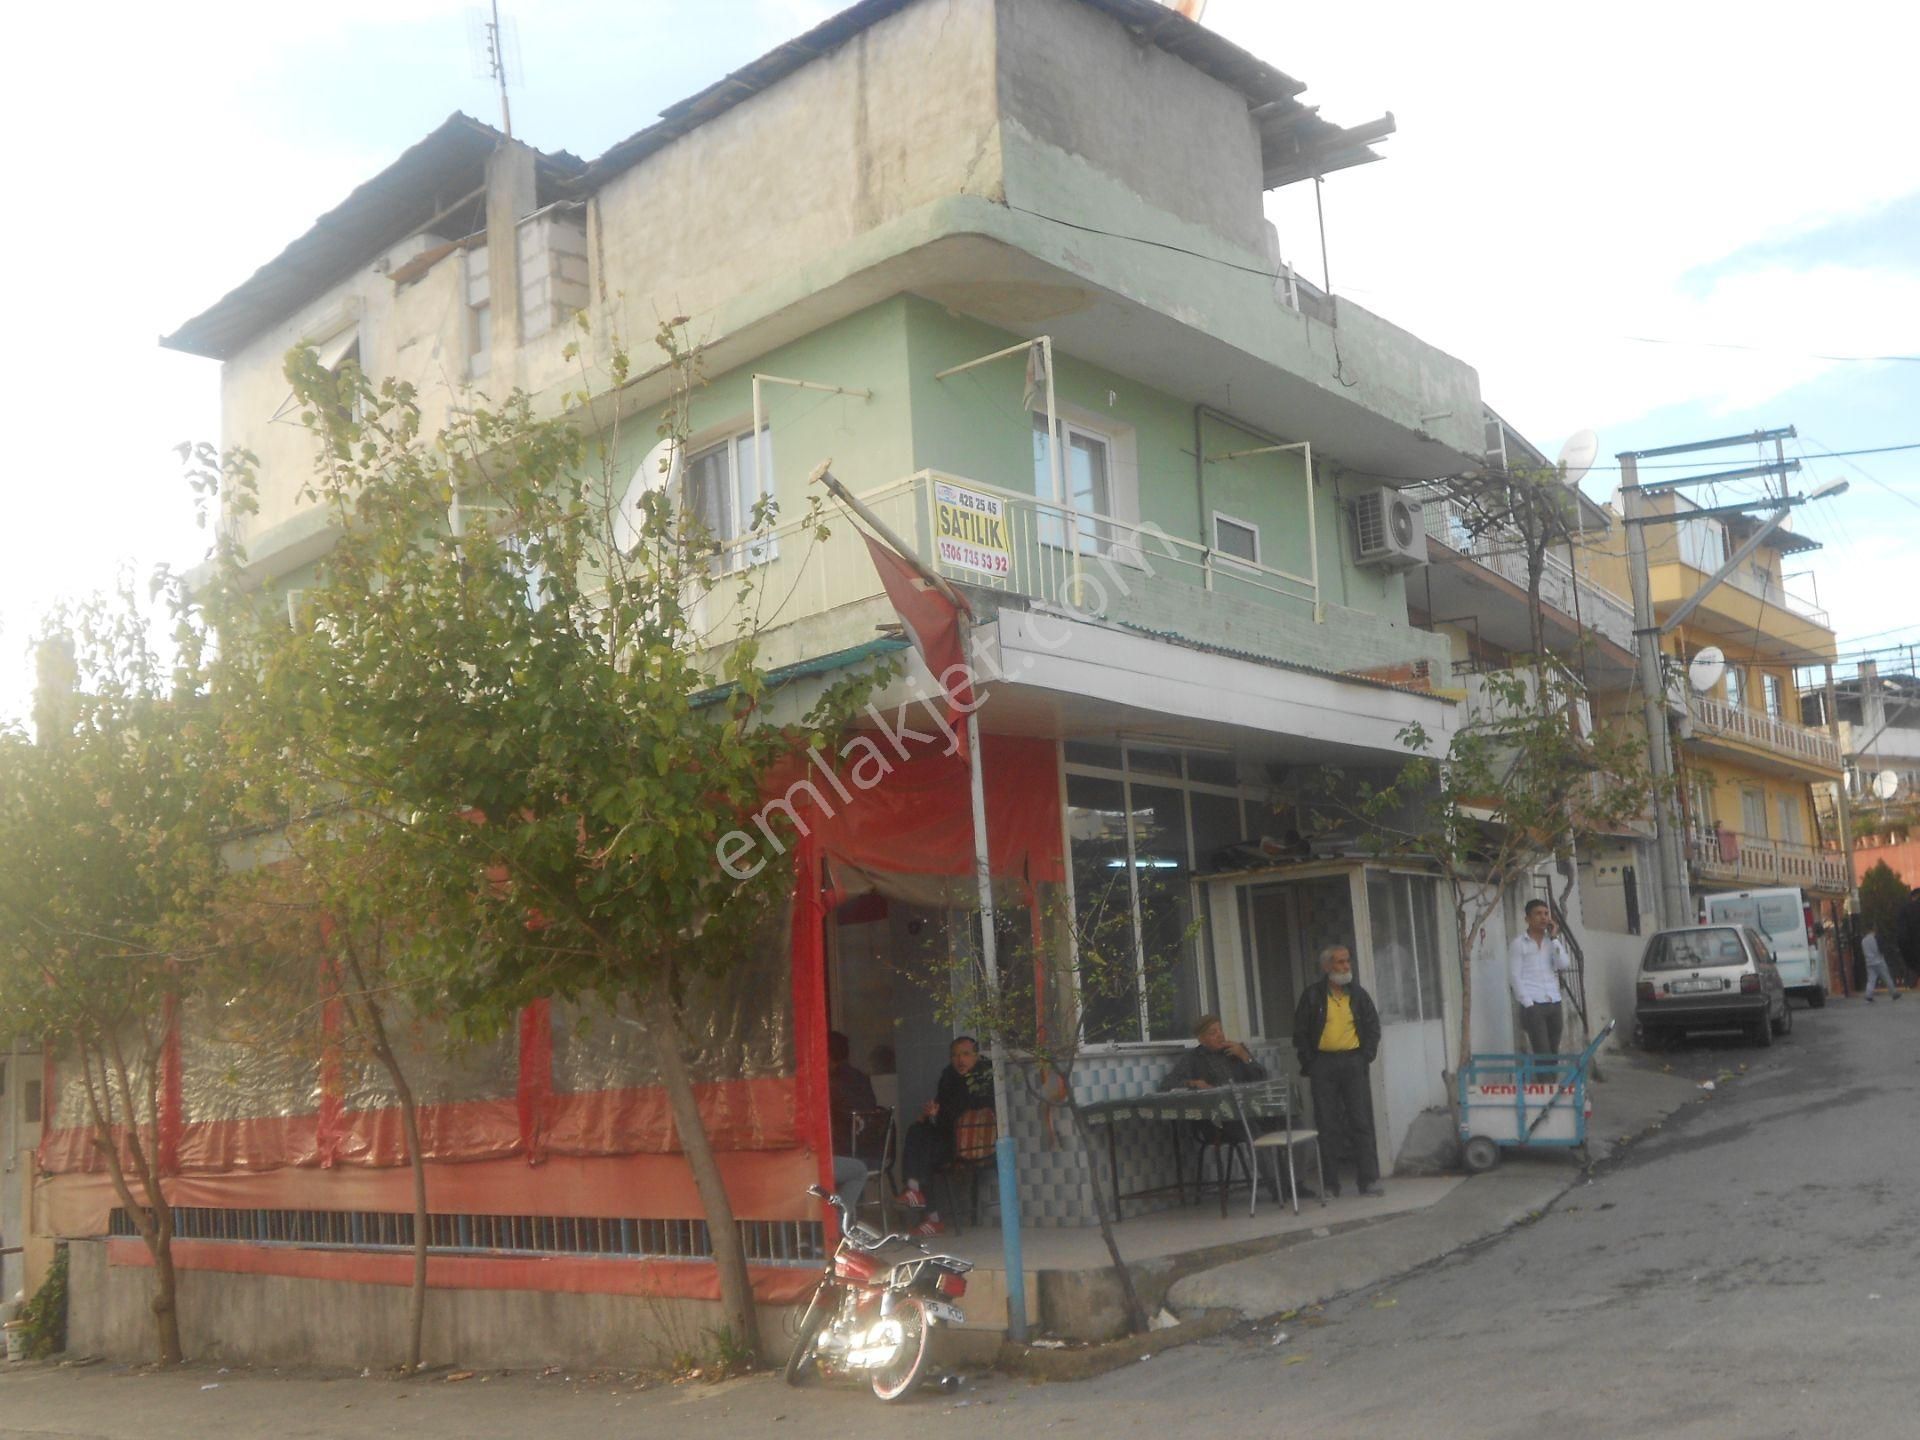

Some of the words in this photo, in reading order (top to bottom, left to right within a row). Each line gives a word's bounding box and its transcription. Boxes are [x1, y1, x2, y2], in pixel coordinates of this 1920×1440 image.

[976, 498, 986, 512] 25
[987, 501, 997, 515] 45
[940, 505, 1003, 549] SATILIK
[964, 549, 979, 565] 735
[981, 554, 992, 569] 53
[995, 556, 1007, 572] 92
